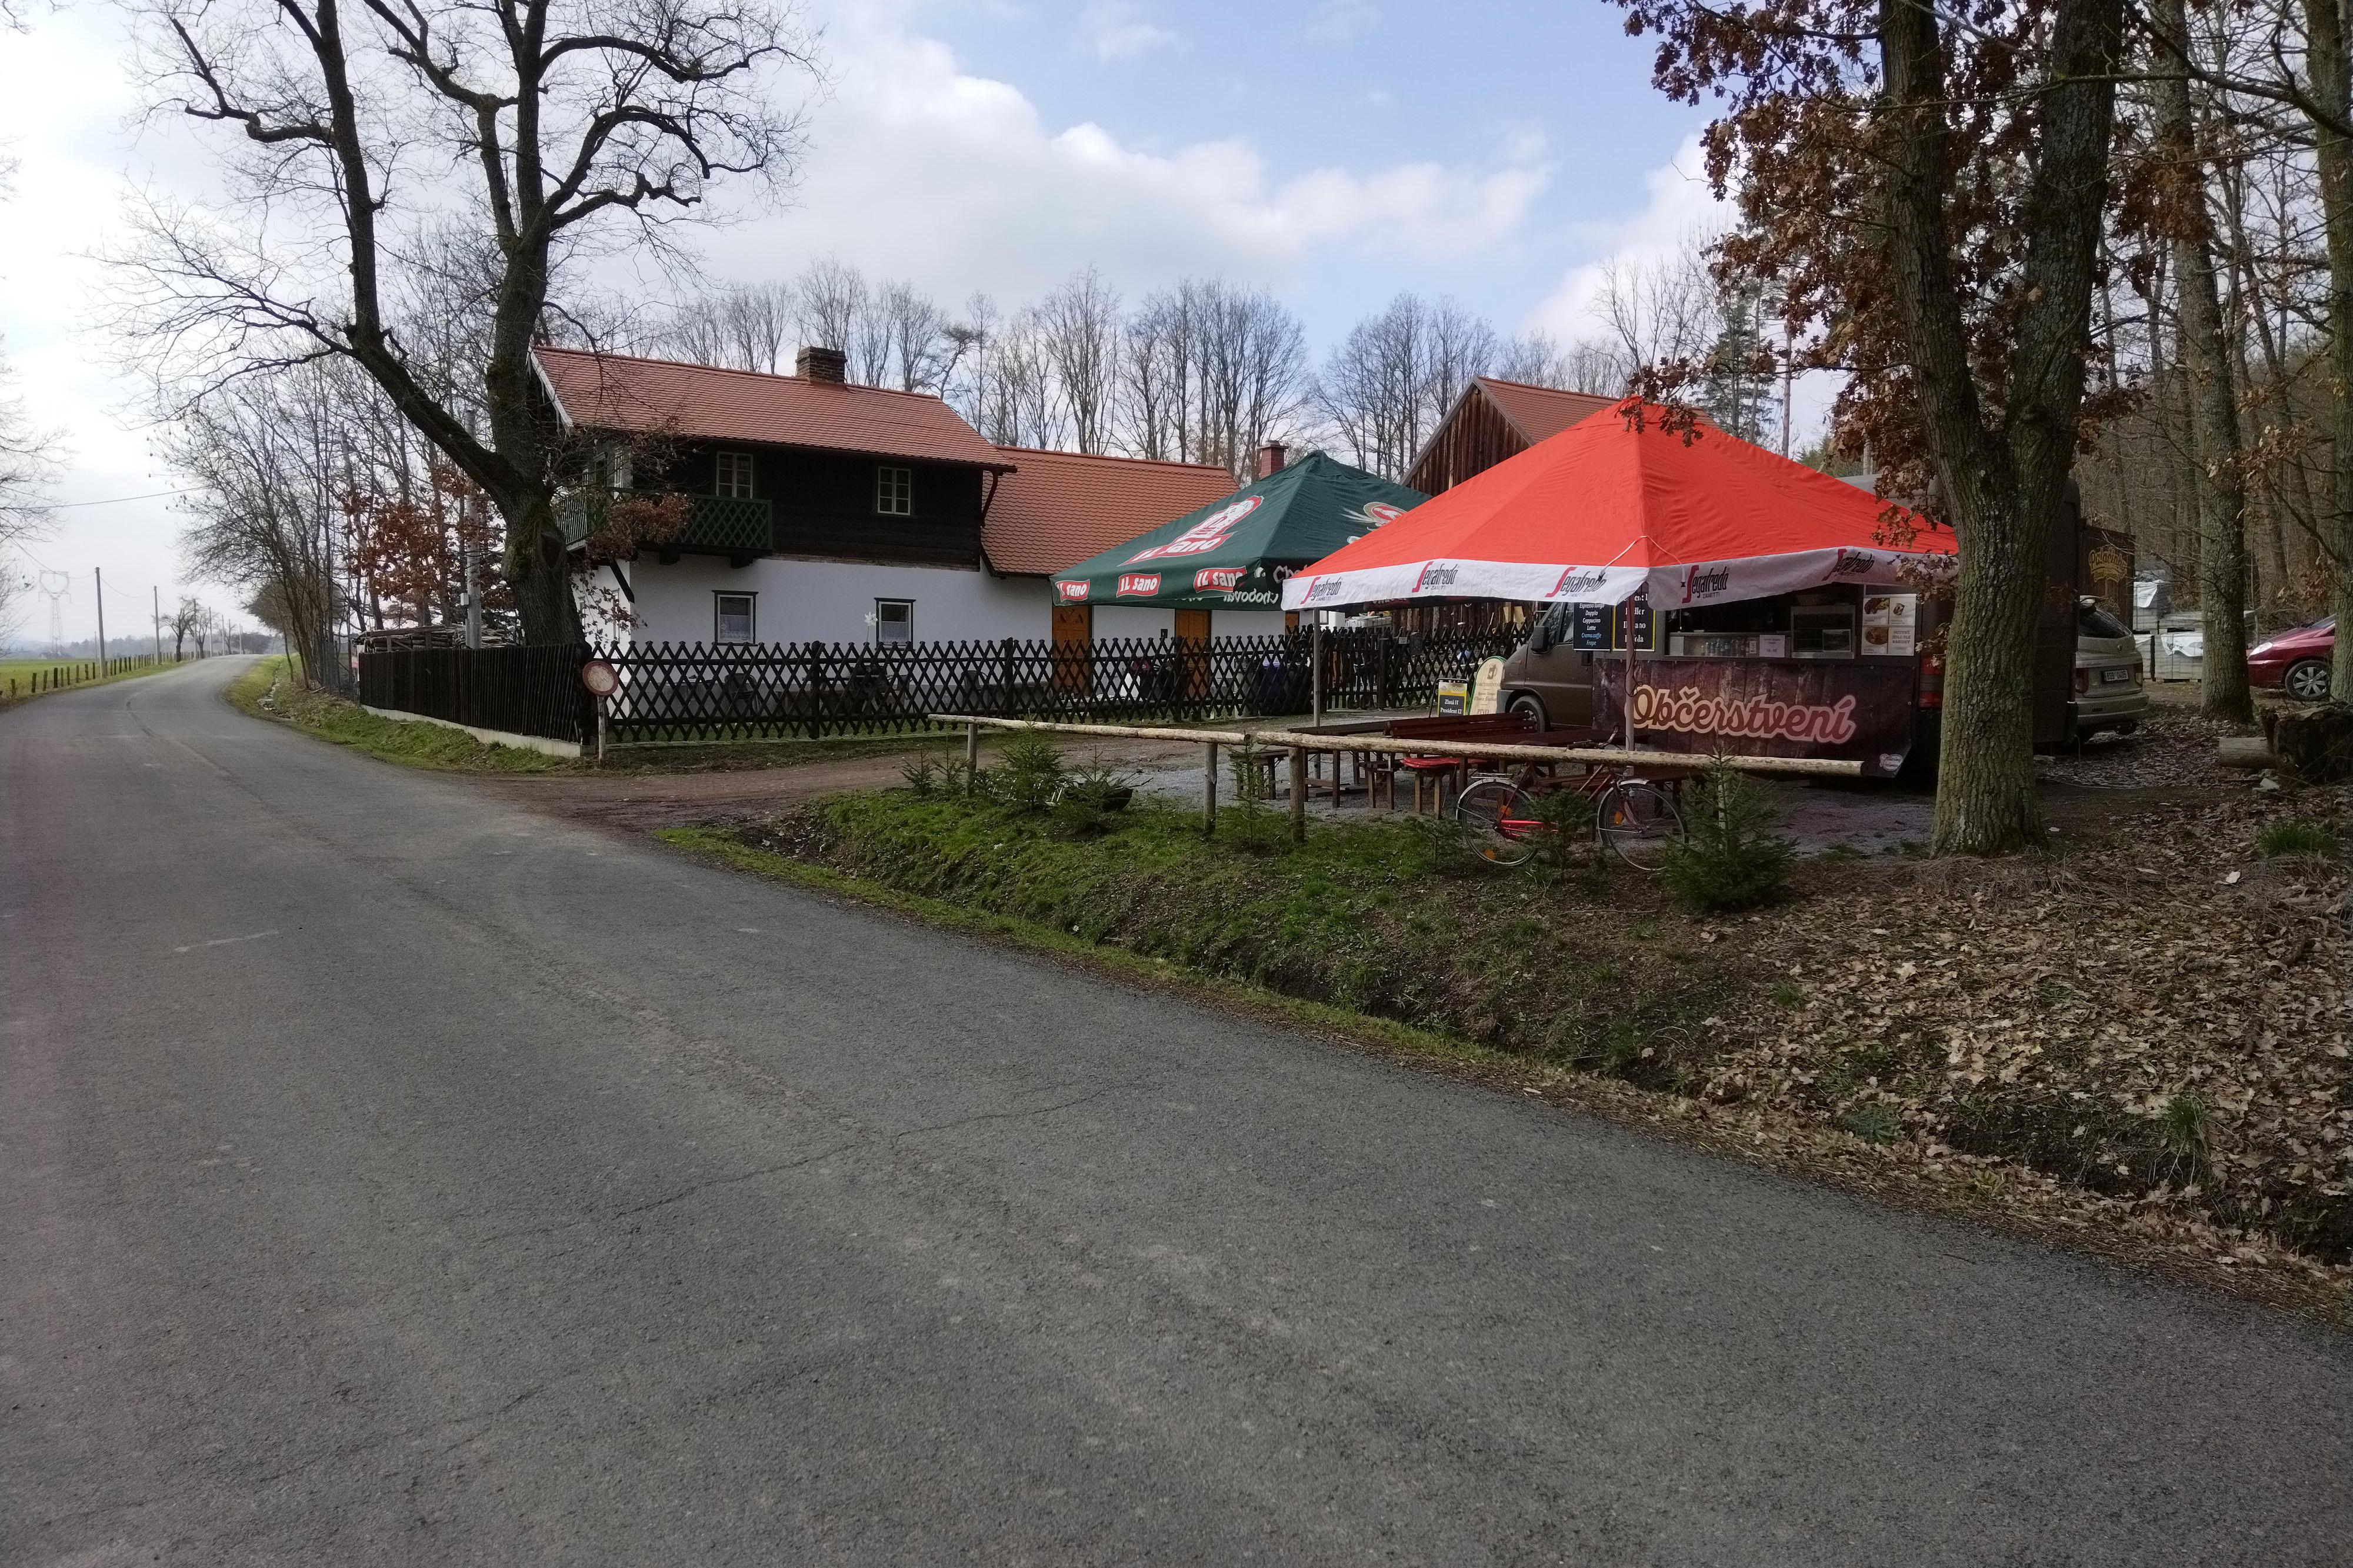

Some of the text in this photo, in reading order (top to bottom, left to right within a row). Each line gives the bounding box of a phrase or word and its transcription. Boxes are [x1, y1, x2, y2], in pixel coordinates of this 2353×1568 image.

[1066, 584, 1086, 596] sano
[1132, 578, 1157, 591] sano
[1300, 576, 1342, 605] Segafredo
[1544, 566, 1607, 598] Segafredo
[1682, 565, 1729, 603] Segafredo
[1628, 685, 1855, 742] Občerstvení
